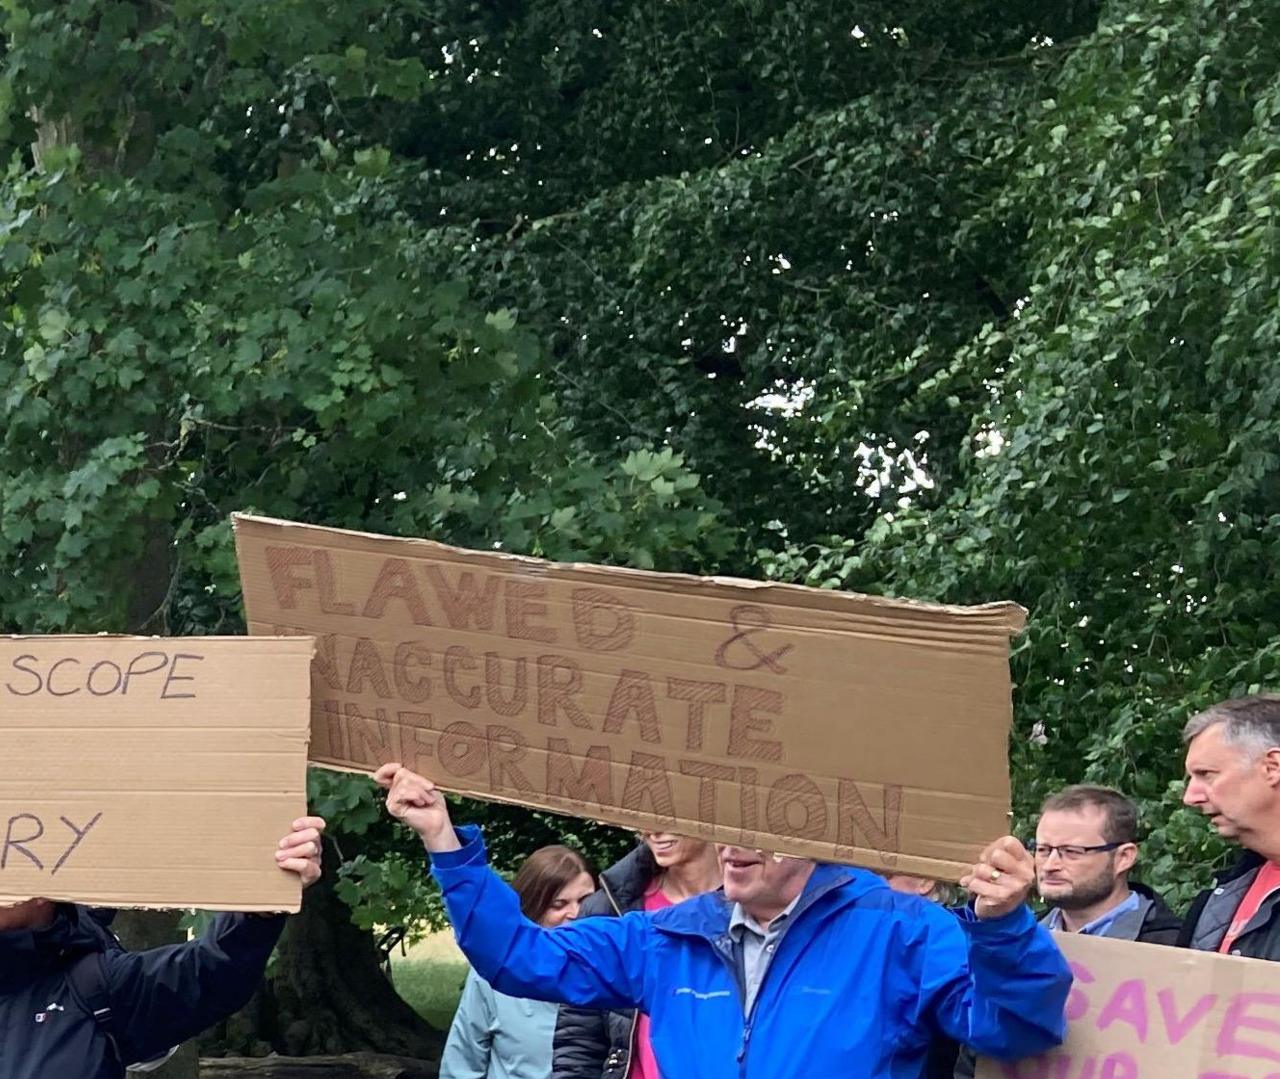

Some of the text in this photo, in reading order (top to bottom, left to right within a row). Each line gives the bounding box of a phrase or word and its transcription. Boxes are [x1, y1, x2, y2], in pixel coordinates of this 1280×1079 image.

[5, 651, 205, 701] SCOPE
[265, 545, 798, 676] FLAWED &
[274, 624, 784, 764] NACCURATE
[323, 699, 905, 866] INFORMATION
